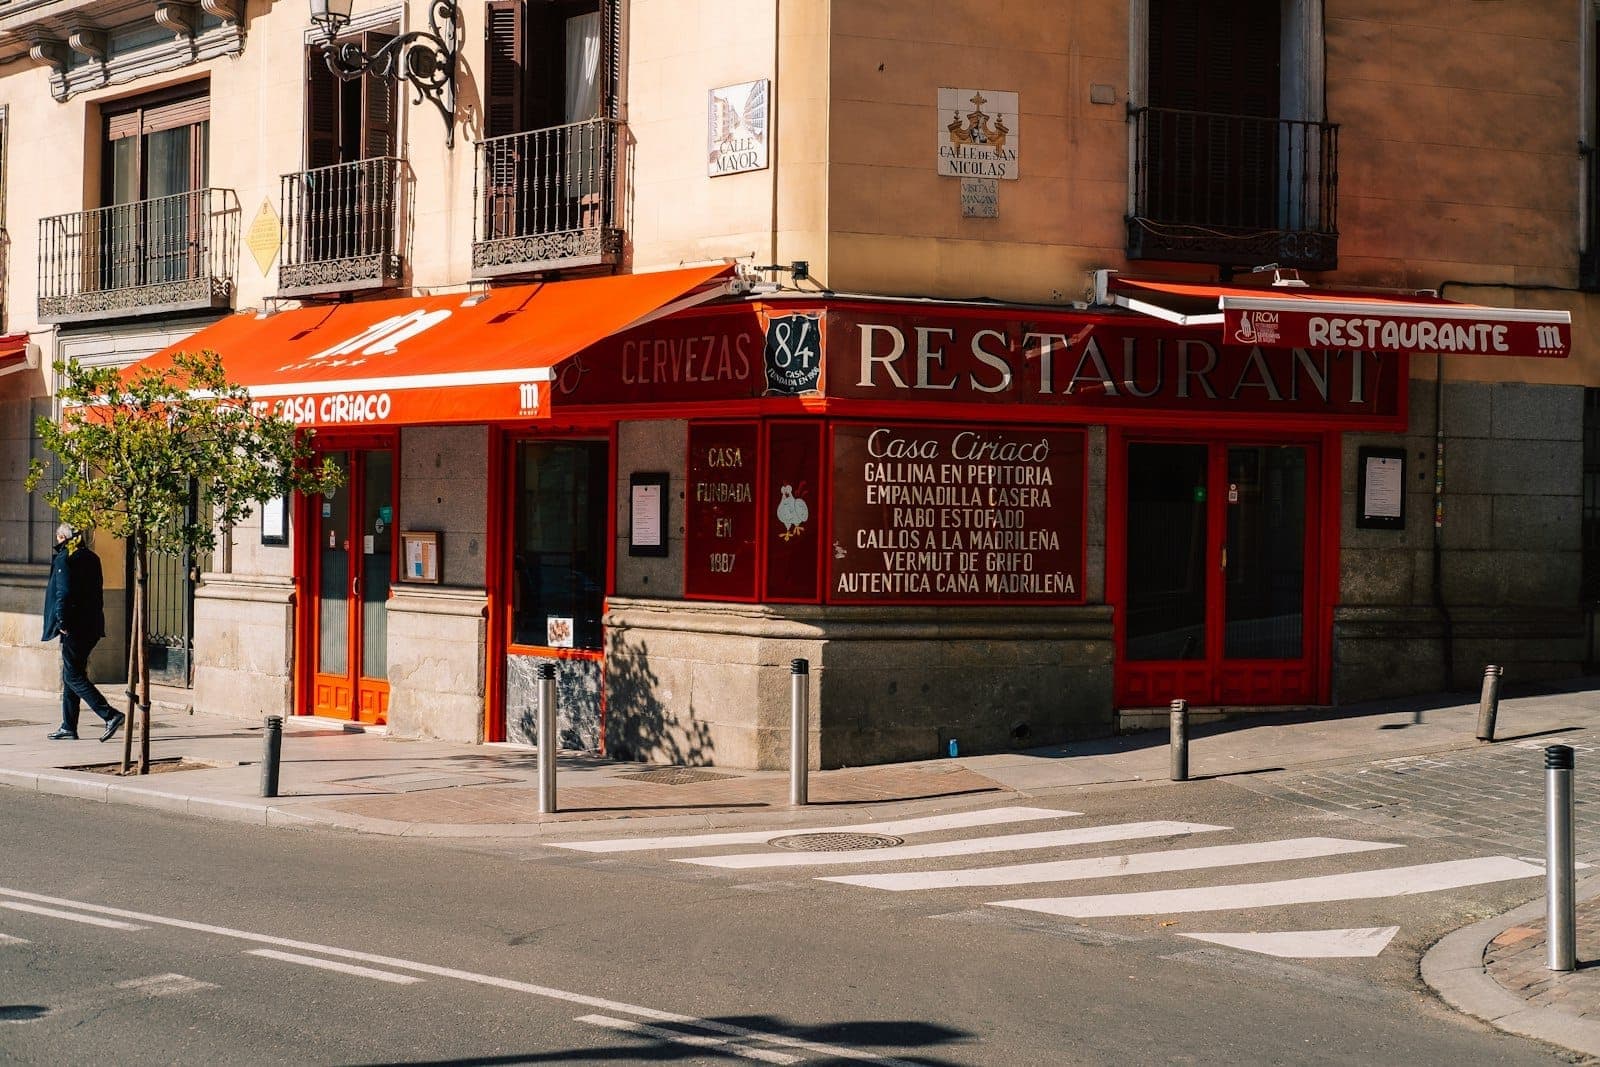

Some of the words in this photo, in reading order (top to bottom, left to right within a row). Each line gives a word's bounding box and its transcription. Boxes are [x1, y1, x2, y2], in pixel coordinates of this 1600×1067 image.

[720, 138, 754, 154] CALLE
[940, 146, 976, 160] CALLE
[978, 151, 992, 160] DE
[993, 150, 1016, 161] SAN
[716, 151, 760, 172] MAYOR
[949, 160, 1006, 176] NICOLAS
[1255, 311, 1279, 323] RCM
[775, 322, 814, 367] 84
[1308, 317, 1509, 352] RESTAURANTE
[622, 333, 751, 384] CERVEZAS
[856, 323, 1378, 404] RESTAURANT
[785, 369, 805, 379] CASA
[867, 428, 939, 459] Casa
[951, 431, 1050, 462] Ciriaco
[708, 447, 743, 468] CASA
[864, 462, 936, 484] GALLINA
[941, 464, 962, 484] EN
[967, 464, 1053, 485] PEPITORIA
[696, 482, 752, 503] FUNDADA
[866, 485, 982, 506] EMPANADILLA
[988, 487, 1052, 508] CASERA
[716, 518, 732, 538] EN
[893, 507, 935, 528] RABO
[941, 508, 1025, 529] ESTOFADO
[856, 529, 920, 550] CALLOS
[925, 530, 936, 550] A
[942, 531, 963, 550] LA
[969, 528, 1060, 550] MADRILEÑA
[709, 553, 736, 573] 1887
[883, 551, 956, 572] VERMUT
[959, 552, 979, 572] DE
[986, 552, 1033, 572] GRIFO
[838, 573, 931, 593] AUTENTICA
[936, 570, 980, 593] CAÑA
[985, 571, 1075, 593] MADRILEÑA
